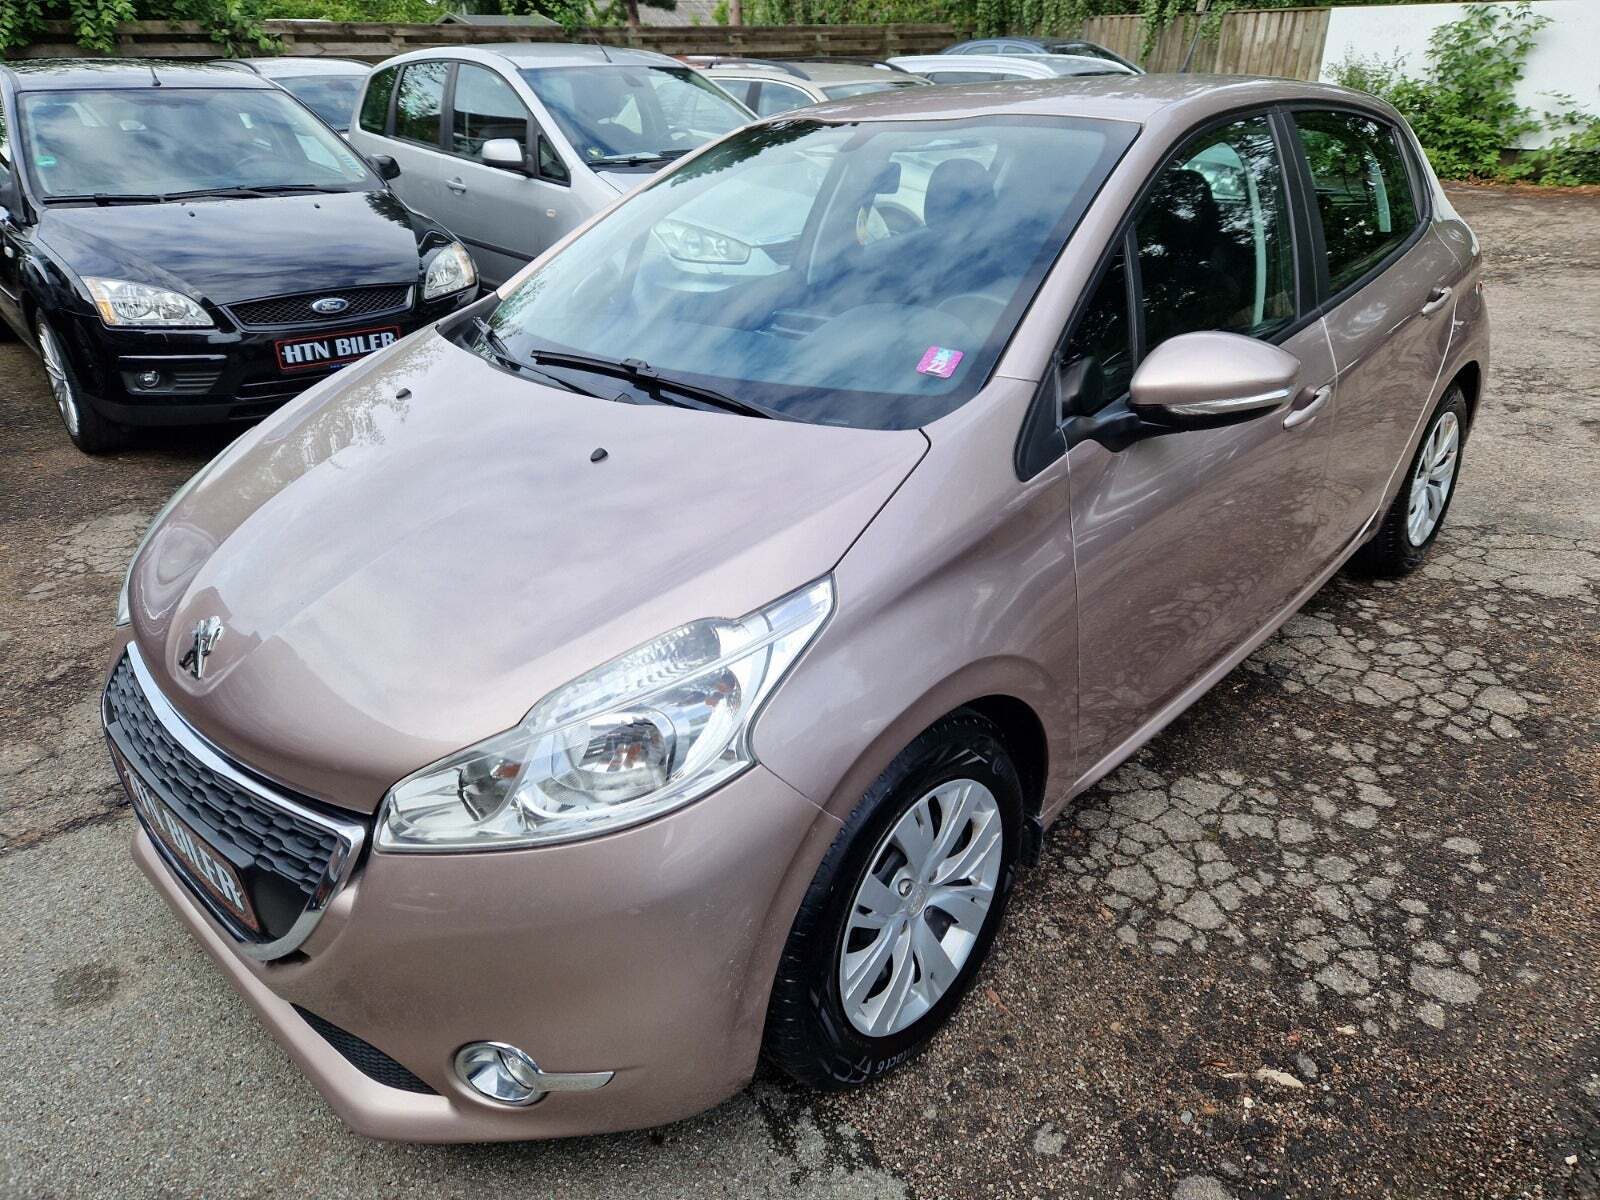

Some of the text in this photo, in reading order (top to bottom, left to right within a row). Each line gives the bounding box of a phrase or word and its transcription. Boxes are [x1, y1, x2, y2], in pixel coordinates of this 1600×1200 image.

[283, 332, 395, 363] HTN BILER
[163, 808, 244, 912] BILER
